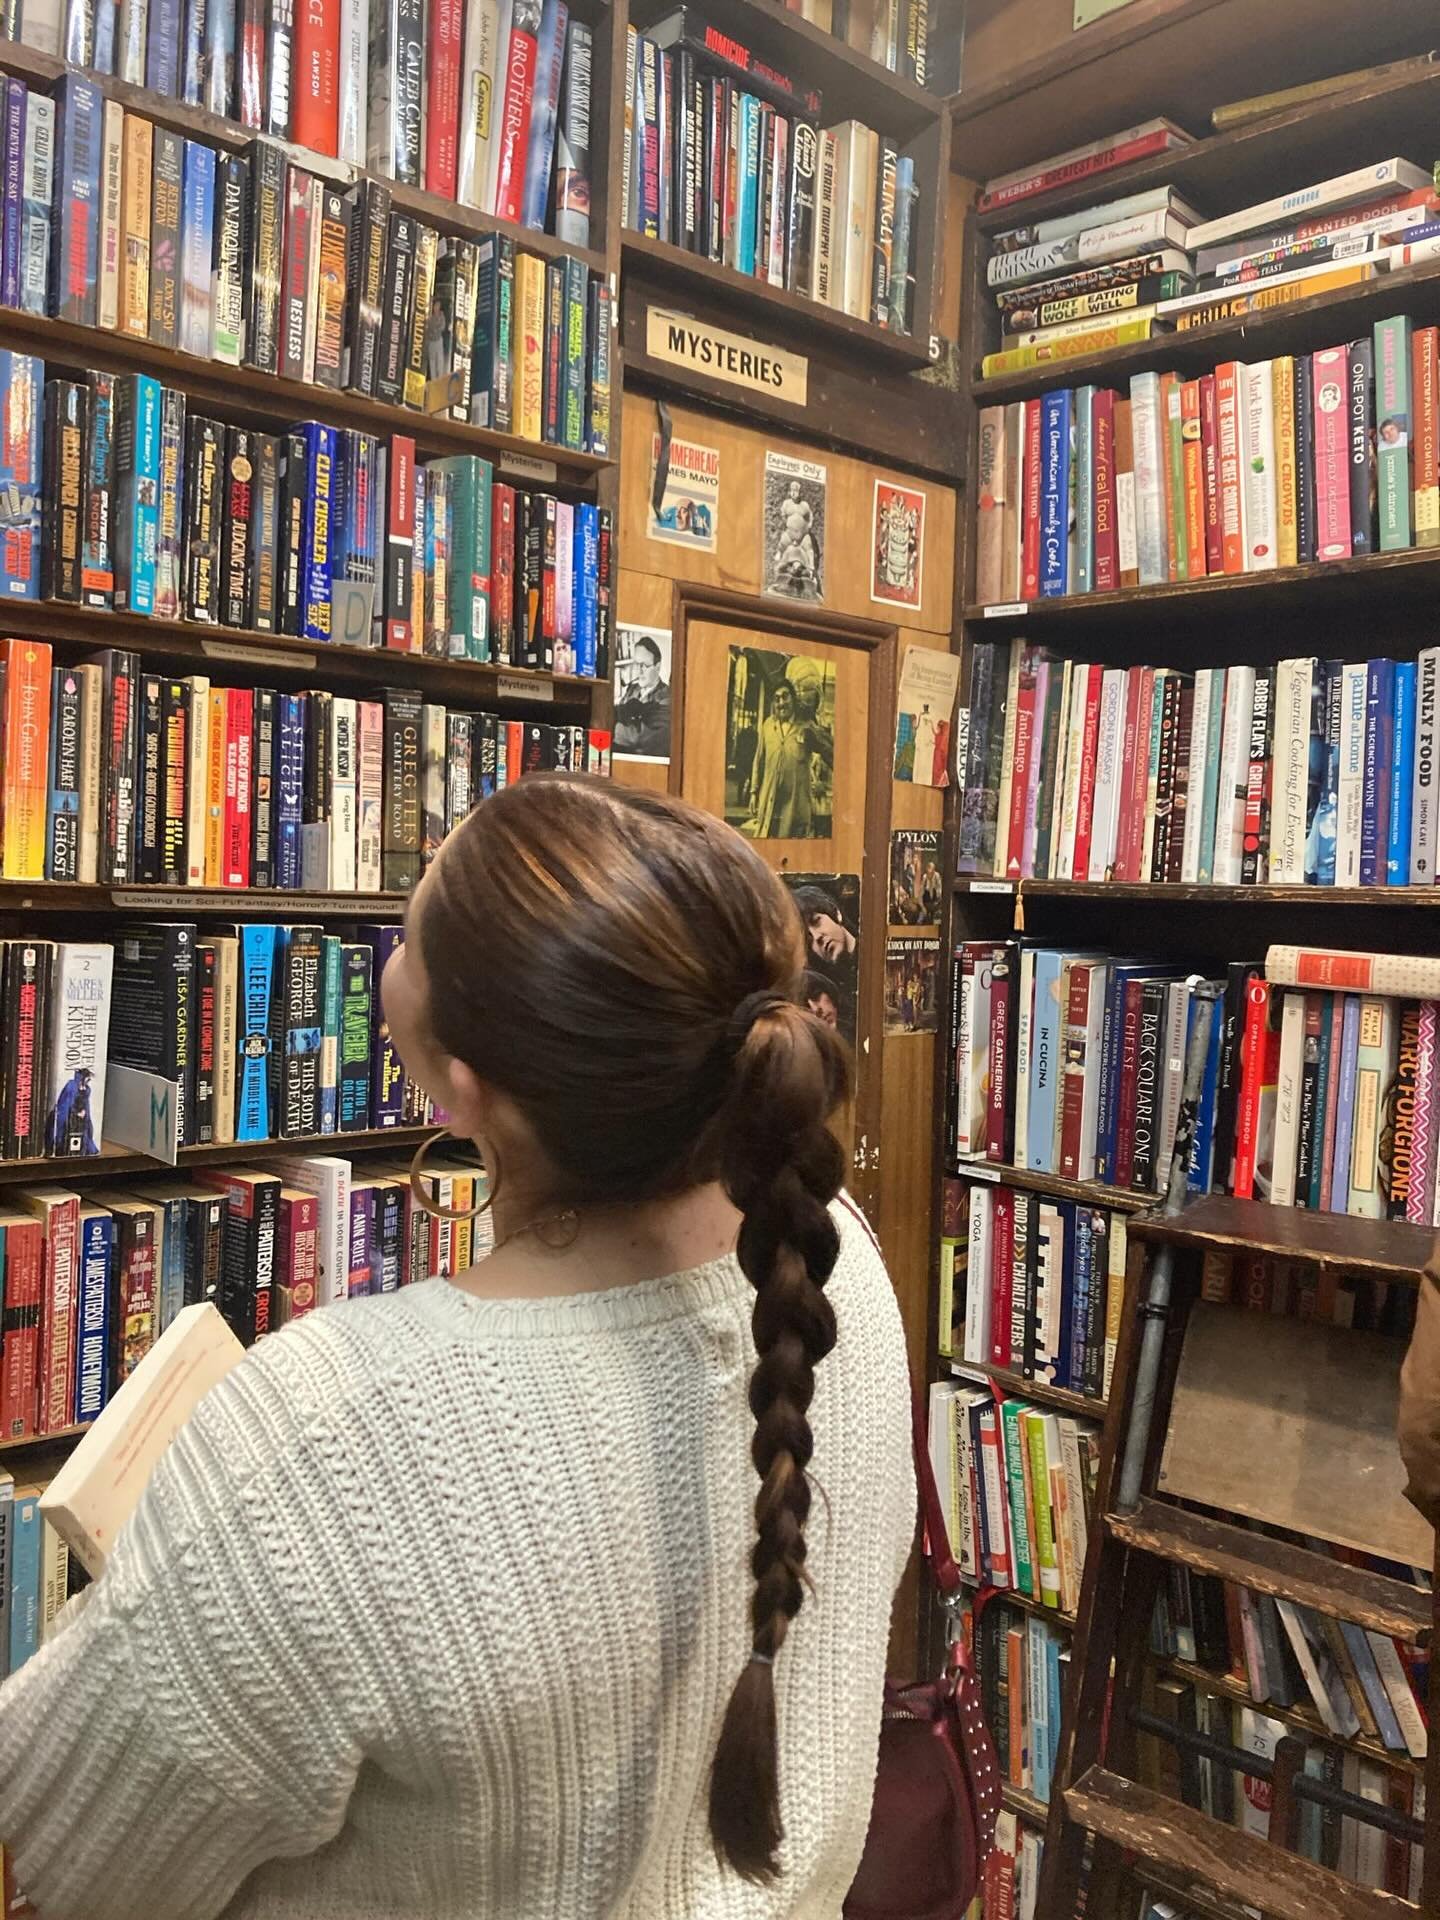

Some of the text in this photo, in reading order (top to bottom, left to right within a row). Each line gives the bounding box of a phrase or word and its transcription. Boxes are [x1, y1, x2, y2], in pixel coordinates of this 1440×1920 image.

[311, 50, 321, 98] DAWSON
[705, 26, 750, 72] HOMICIDE
[405, 41, 422, 155] CALEB CARR
[476, 79, 489, 130] Capone
[506, 37, 529, 141] BROTHERS
[8, 104, 20, 202] THE DEVIL YOU SAY
[154, 180, 168, 226] BARTON
[166, 184, 180, 231] BEVERLY
[223, 182, 241, 270] DAN BROWN
[880, 148, 898, 246] KILLINGLY
[1271, 204, 1399, 248] THE SLANTED DOOR
[392, 254, 406, 316] THE CAMEL CLUB
[991, 254, 1057, 284] JOHNSON
[1088, 286, 1135, 303] EATING
[289, 299, 304, 360] RESTLESS
[1043, 299, 1078, 314] BURT
[1043, 308, 1079, 323] WOLF
[1088, 299, 1123, 313] WELL
[317, 318, 341, 367] BRAVER
[668, 325, 783, 386] MYSTERIES
[142, 402, 155, 474] Tom Clancy's
[1352, 363, 1365, 464] ONE POT KETO
[501, 452, 543, 471] Mysteries
[689, 471, 719, 486] MAYO
[803, 462, 821, 476] Only
[1206, 445, 1217, 526] WINE BAR FOOD
[1219, 396, 1240, 536] THE SALVAGE CHEF COOKBOOK
[99, 490, 109, 568] SPLINTER CELL
[313, 453, 331, 565] CLIVE CUSSLER
[414, 496, 425, 558] BILL DUGAN
[229, 519, 248, 601] JUDGING TIME
[583, 524, 592, 575] LIPPMAN
[307, 603, 319, 627] SIX
[318, 601, 332, 634] DEEP
[344, 591, 366, 641] D
[499, 679, 540, 692] Mysteries
[60, 706, 77, 791] CAROLYN HART
[1013, 708, 1034, 774] fandango
[1103, 681, 1119, 785] GORDON RAMSAY'S
[1250, 678, 1270, 759] BOBBY FLAY'S
[1349, 671, 1368, 774] jamie at home
[1418, 656, 1437, 788] MANLY FOOD
[392, 731, 402, 839] CEMETERY ROAD
[403, 726, 418, 846] GREG ILES
[1247, 764, 1264, 817] GRILL IT!
[1283, 671, 1308, 874] Vegetarian Cooking for Everyone
[1364, 716, 1377, 810] THE SCIENCE OF WINE
[53, 817, 69, 877] GHOST
[897, 831, 938, 844] PYLON
[1418, 798, 1429, 848] SIMON CAVE
[124, 896, 173, 908] Looking
[176, 896, 192, 905] for
[332, 901, 357, 911] Turn
[887, 940, 940, 951] KNOCK ON ANY DOOR
[83, 1005, 98, 1030] THE
[247, 966, 267, 1032] LEE CHILD
[290, 957, 304, 1021] GEORGE
[304, 958, 318, 1018] Elizabeth
[176, 976, 188, 1067] LISA GARDNER
[343, 992, 370, 1066] TRAVELER
[1019, 1014, 1028, 1075] SPA FOOD
[1123, 1011, 1137, 1072] CHEESE
[1251, 1023, 1260, 1051] OPRAH
[993, 1001, 1006, 1110] GREAT GATHERINGS
[1038, 1027, 1050, 1089] IN CUCINA
[151, 1087, 170, 1150] M
[301, 1059, 316, 1131] THIS BODY
[1133, 1013, 1159, 1165] BACK SQUARE ONE
[1391, 1010, 1418, 1201] MARC FORGIONE
[1243, 1099, 1253, 1144] COOKBOOK
[1299, 1077, 1313, 1179] The Paley's Place Cookbook
[351, 1213, 367, 1267] ANN RULE
[972, 1212, 982, 1243] YOGA
[1013, 1195, 1028, 1241] FOOD 2.0
[1078, 1222, 1091, 1271] patricia yeo
[54, 1249, 72, 1312] PATTERSON
[256, 1229, 275, 1289] PATTERSON
[292, 1230, 307, 1280] ROSENBERG
[255, 1290, 271, 1332] CROSS
[1011, 1260, 1027, 1347] CHARLIE AYERS
[80, 1336, 104, 1414] HONEYMOON
[1006, 1415, 1023, 1474] EATING ANIMALS
[1041, 1504, 1052, 1560] KITCHEN
[1253, 1735, 1266, 1749] 75
